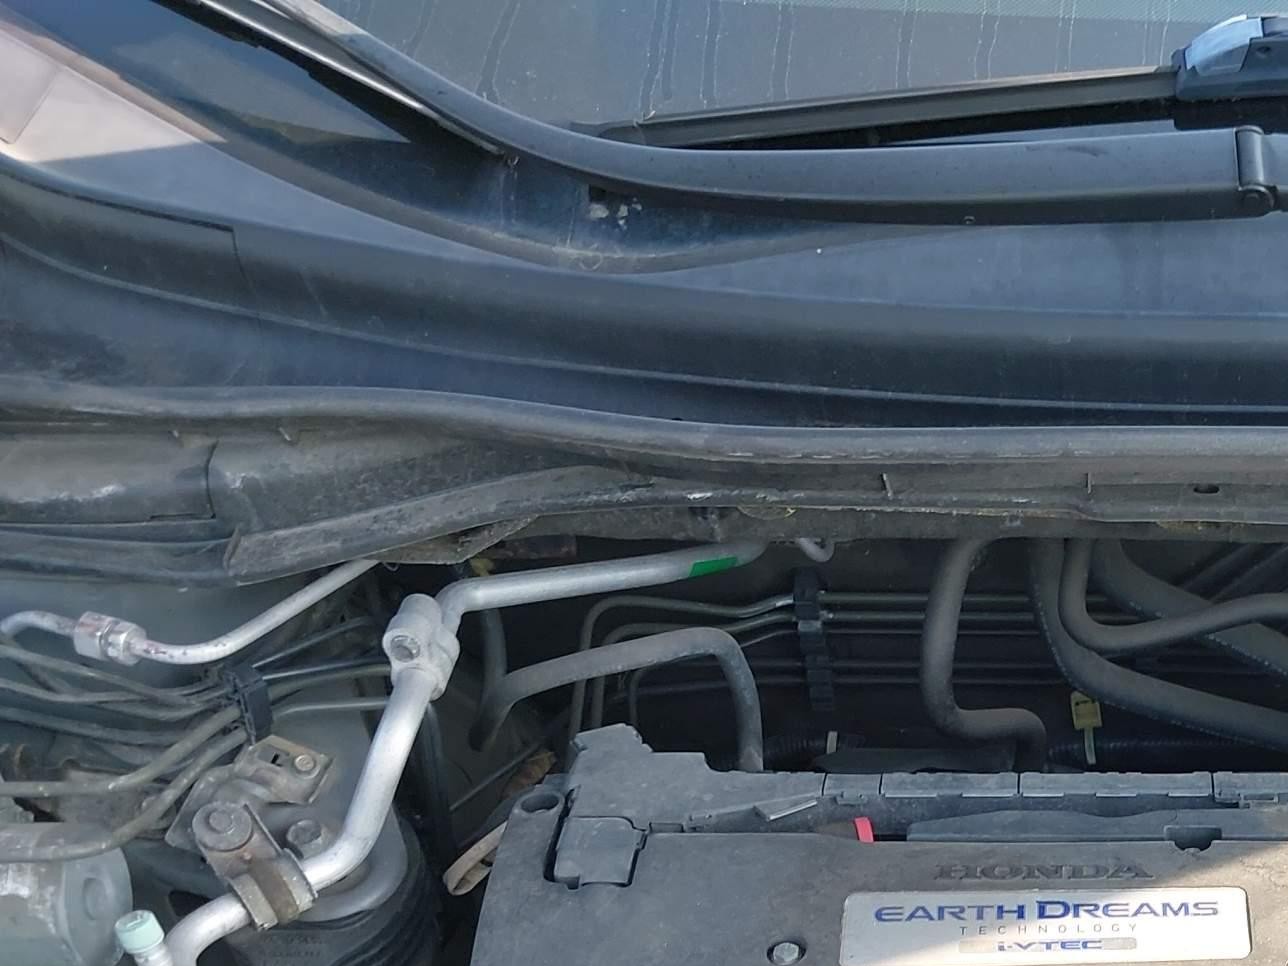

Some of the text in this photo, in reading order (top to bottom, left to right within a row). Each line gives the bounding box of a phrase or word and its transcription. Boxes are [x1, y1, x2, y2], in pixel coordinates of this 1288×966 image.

[934, 864, 1154, 881] HONDA
[875, 900, 1219, 922] EARTH DREAMS
[960, 923, 1138, 936] TECHNOLOGY
[997, 940, 1102, 952] i-VTEC
